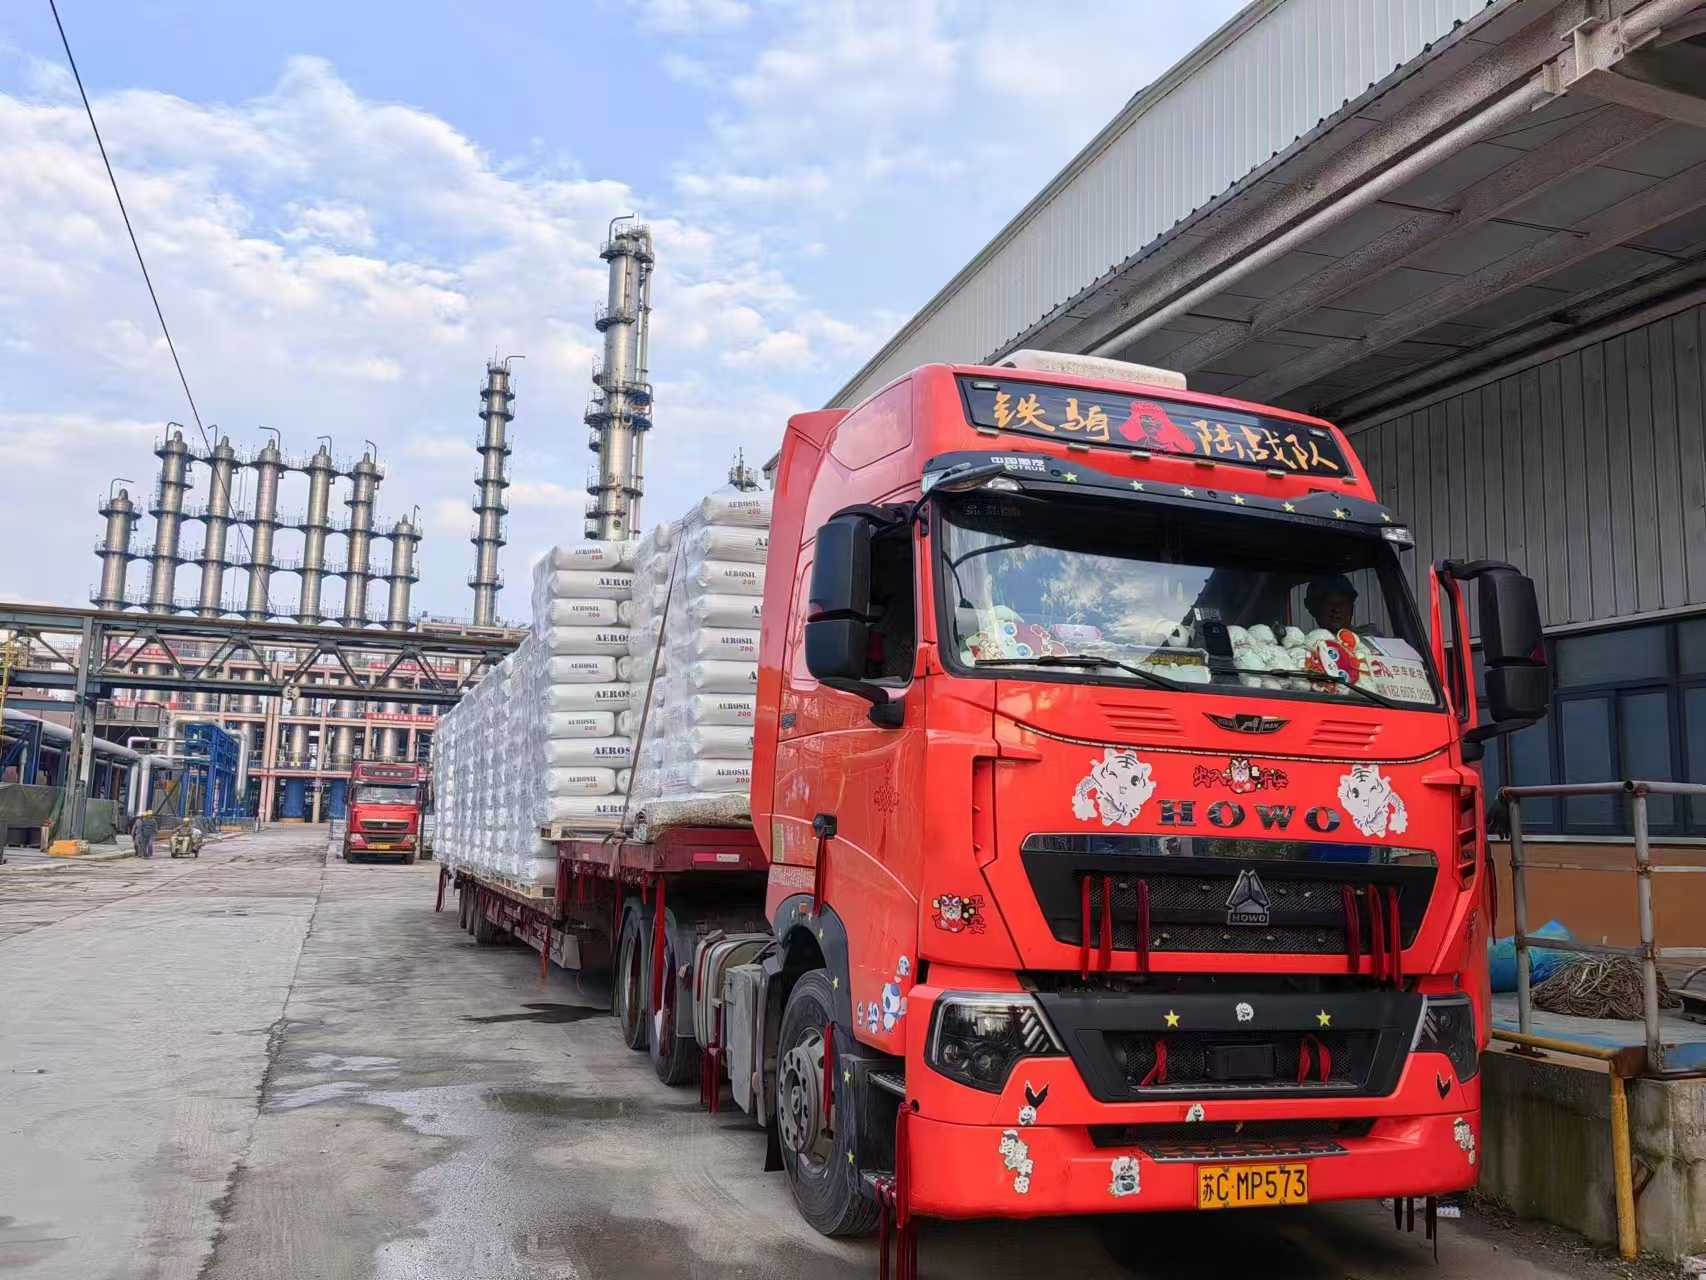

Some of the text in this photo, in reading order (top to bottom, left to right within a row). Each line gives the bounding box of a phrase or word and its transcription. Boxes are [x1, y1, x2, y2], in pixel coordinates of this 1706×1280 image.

[728, 500, 760, 508] AEROSIL
[724, 570, 756, 578] AEROSIL
[721, 636, 753, 645] AEROSIL
[716, 768, 750, 776] AEROSIL
[1157, 800, 1341, 833] HOWO
[1232, 913, 1267, 922] HOWO
